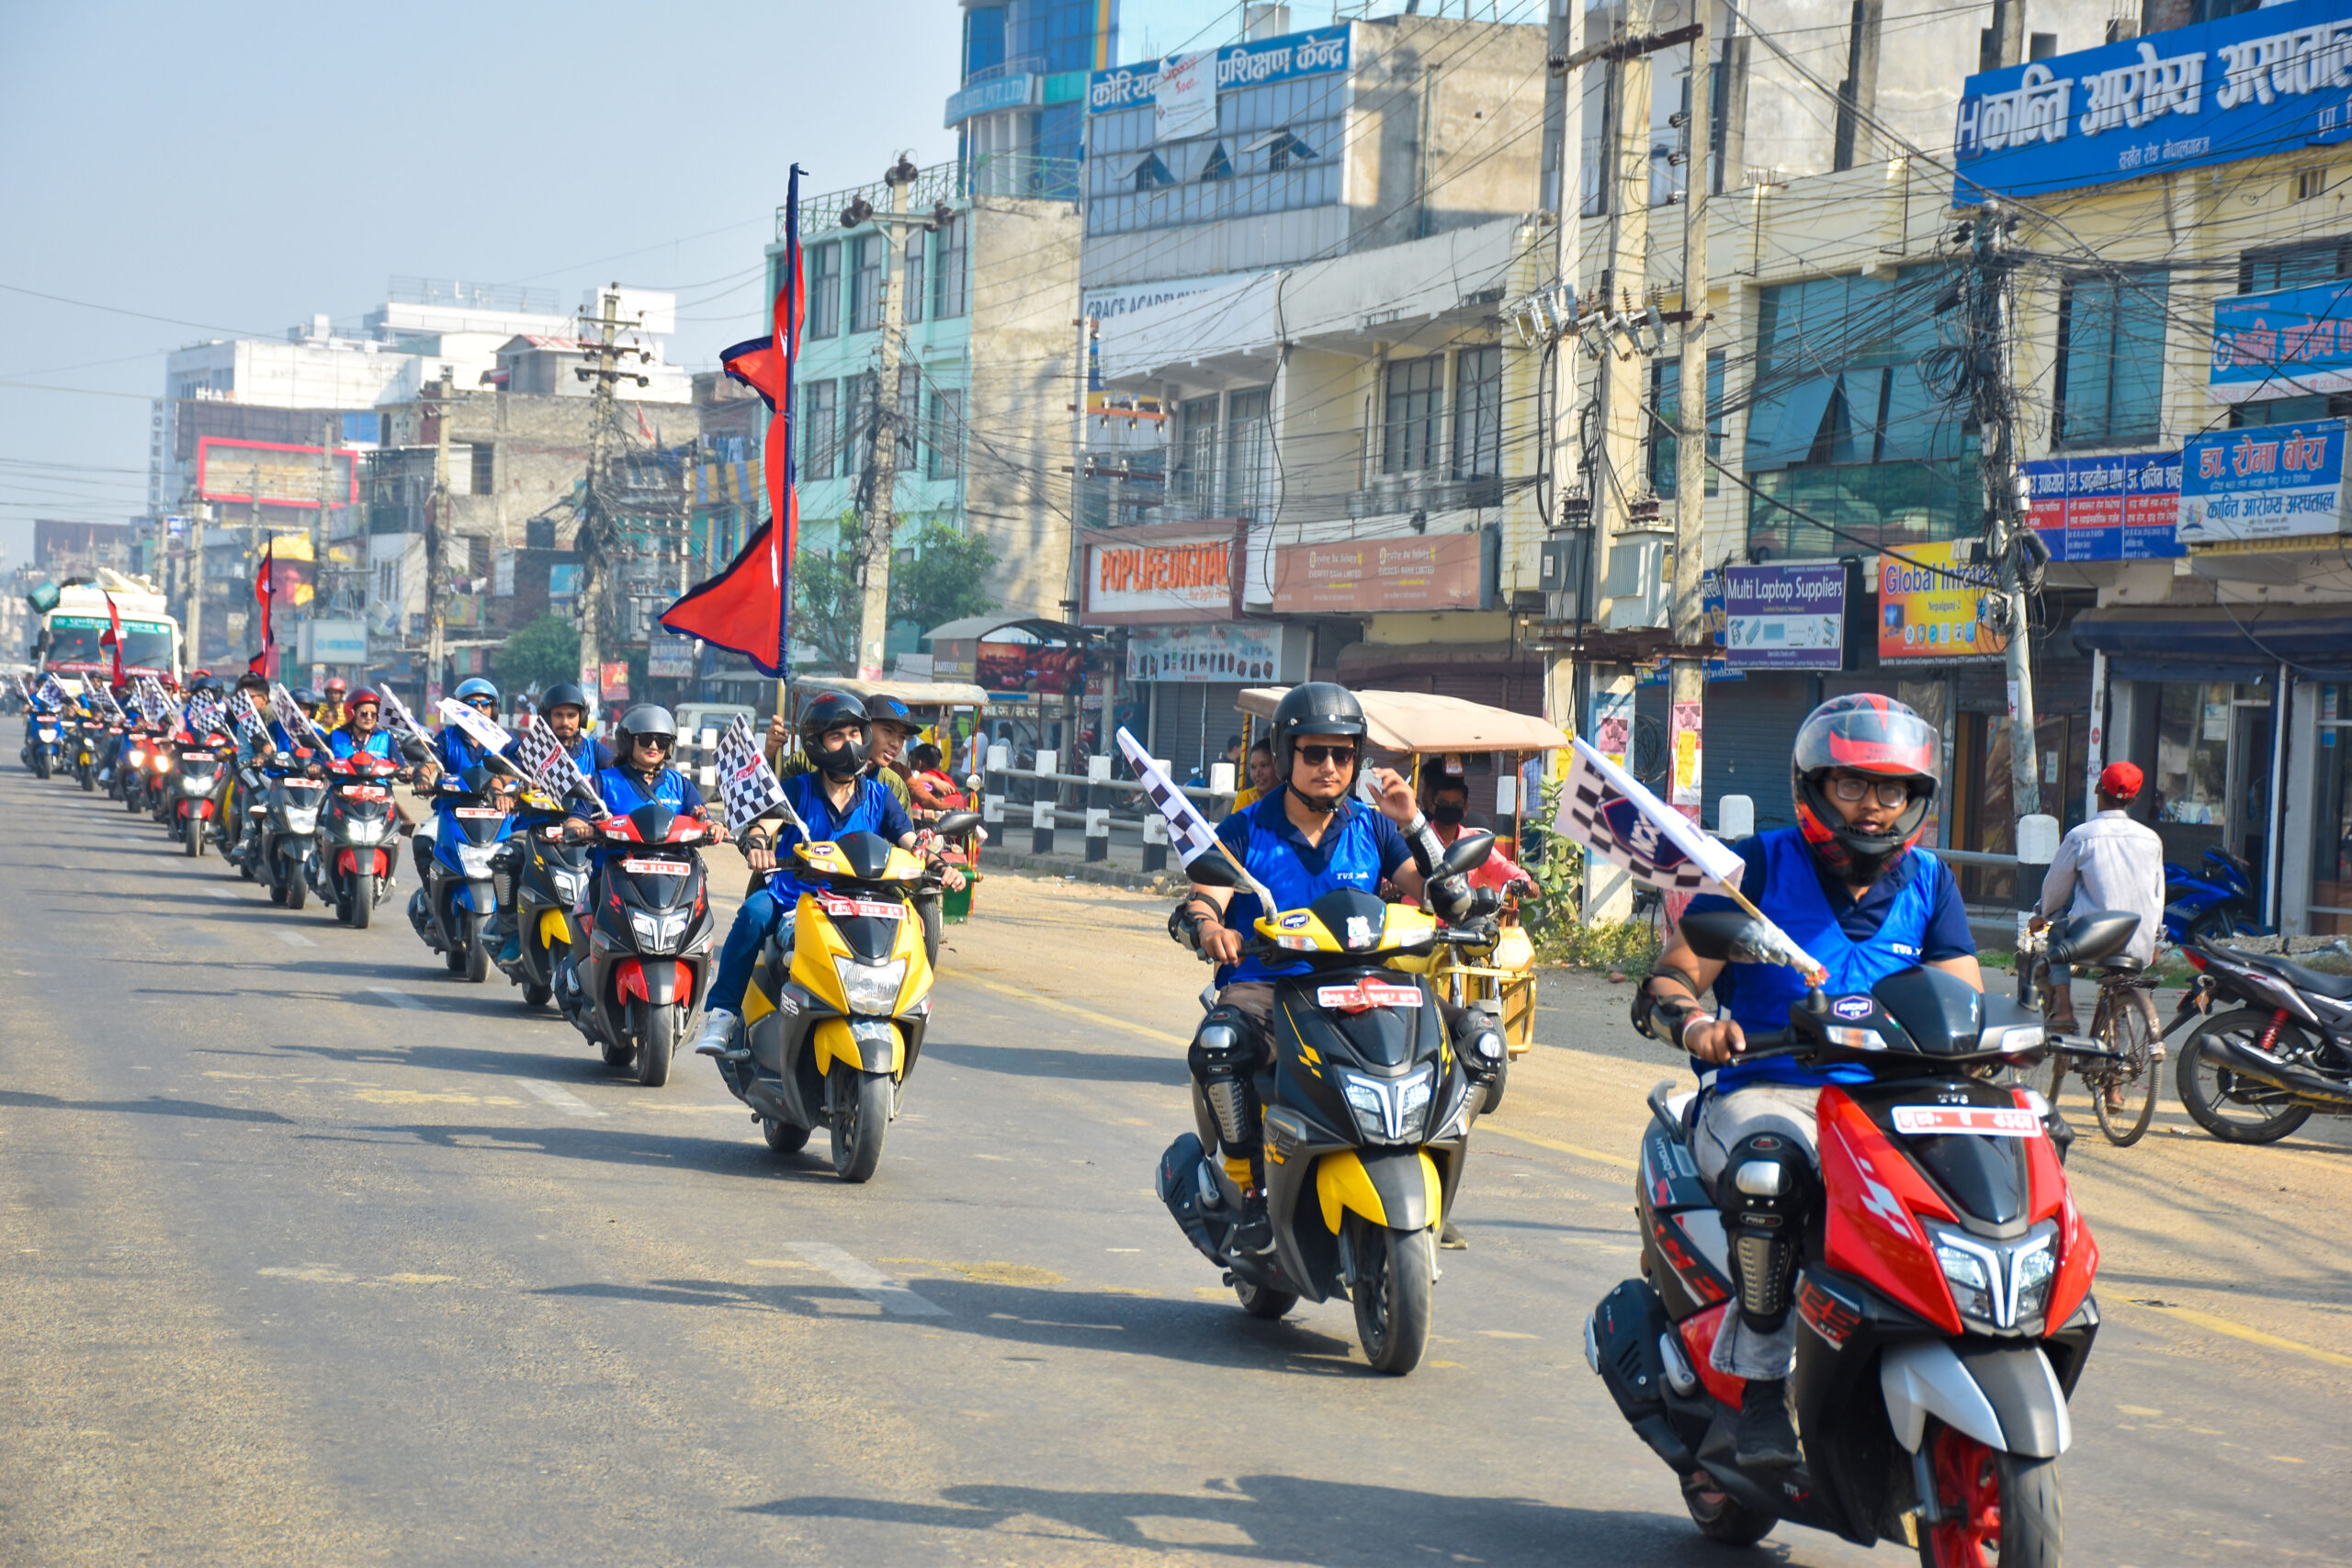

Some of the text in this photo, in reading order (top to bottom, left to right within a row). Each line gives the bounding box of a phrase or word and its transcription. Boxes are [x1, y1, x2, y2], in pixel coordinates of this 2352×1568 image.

[1217, 45, 1290, 88] प्रशिक्षण
[1297, 35, 1346, 71] केन्द्र
[1982, 64, 2074, 151] कान्ति
[2080, 42, 2206, 137] आरोग्य
[2199, 429, 2328, 479] डा. रोमा बोरा
[2207, 491, 2336, 519] कान्ति आरोग्य अस्पताल
[1100, 540, 1229, 593] POP LIFE DIGITAL
[1884, 561, 1936, 596] Global
[1727, 576, 1843, 603] Multi Laptop Suppliers
[1337, 872, 1353, 880] TVS
[1893, 942, 1913, 955] TVS
